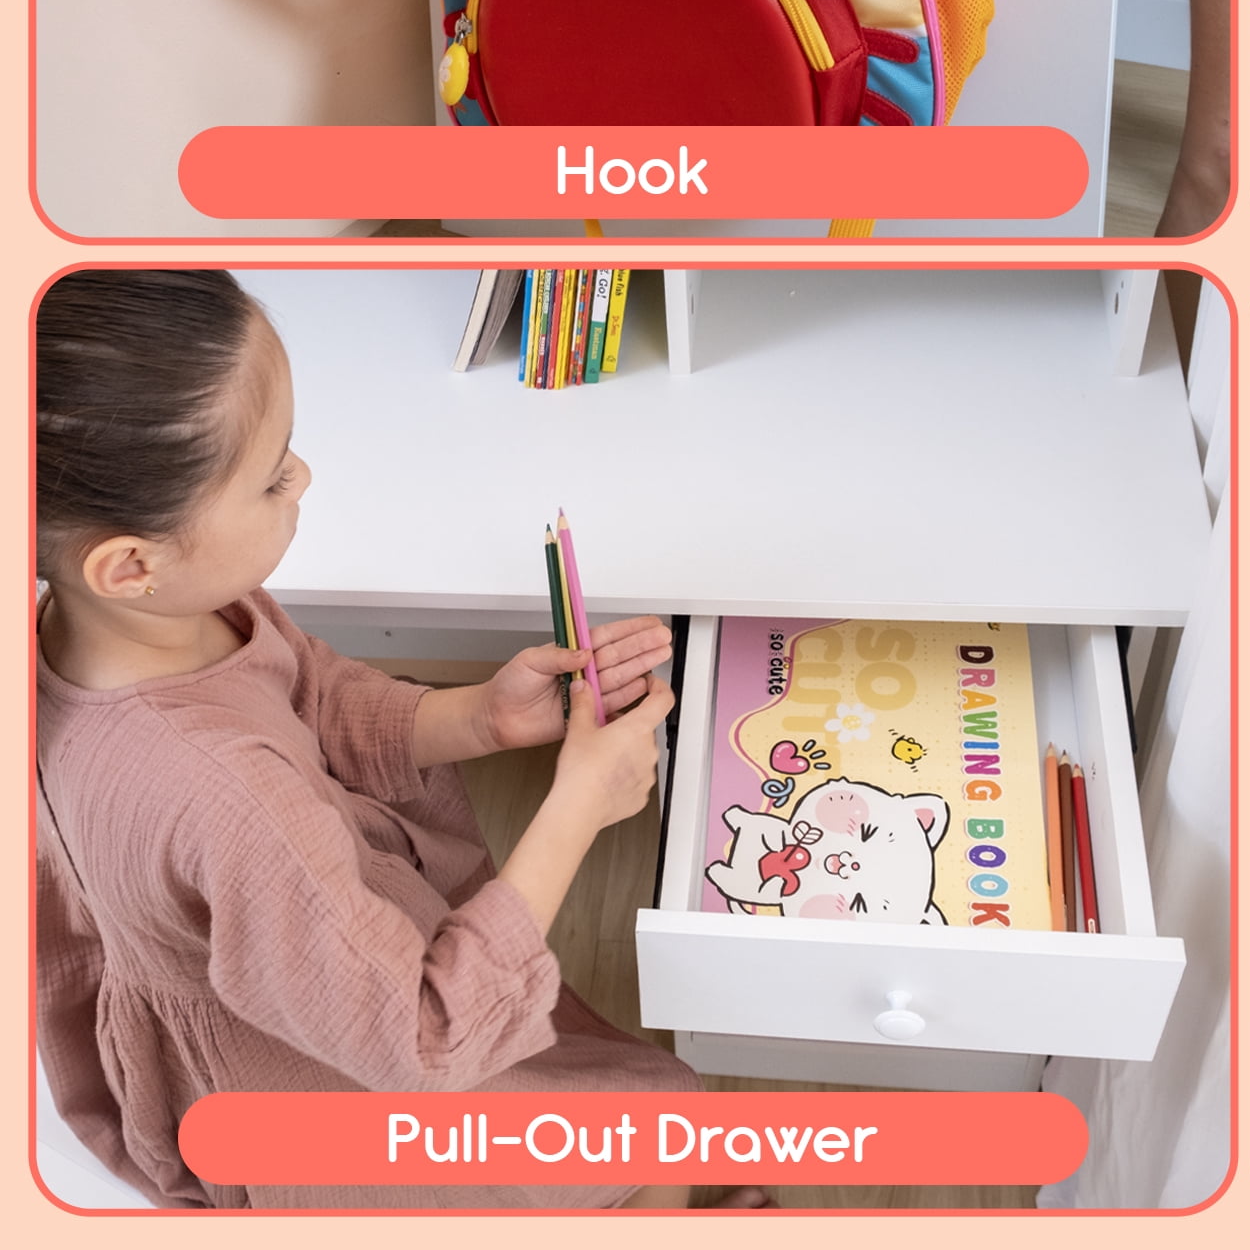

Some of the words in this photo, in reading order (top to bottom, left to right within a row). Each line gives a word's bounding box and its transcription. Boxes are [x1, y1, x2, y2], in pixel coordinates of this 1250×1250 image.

[596, 278, 609, 299] Go!
[615, 283, 625, 296] fish
[770, 633, 784, 651] so
[768, 657, 788, 696] cute
[956, 645, 1002, 803] DRAWING
[966, 818, 1011, 928] BOOK
